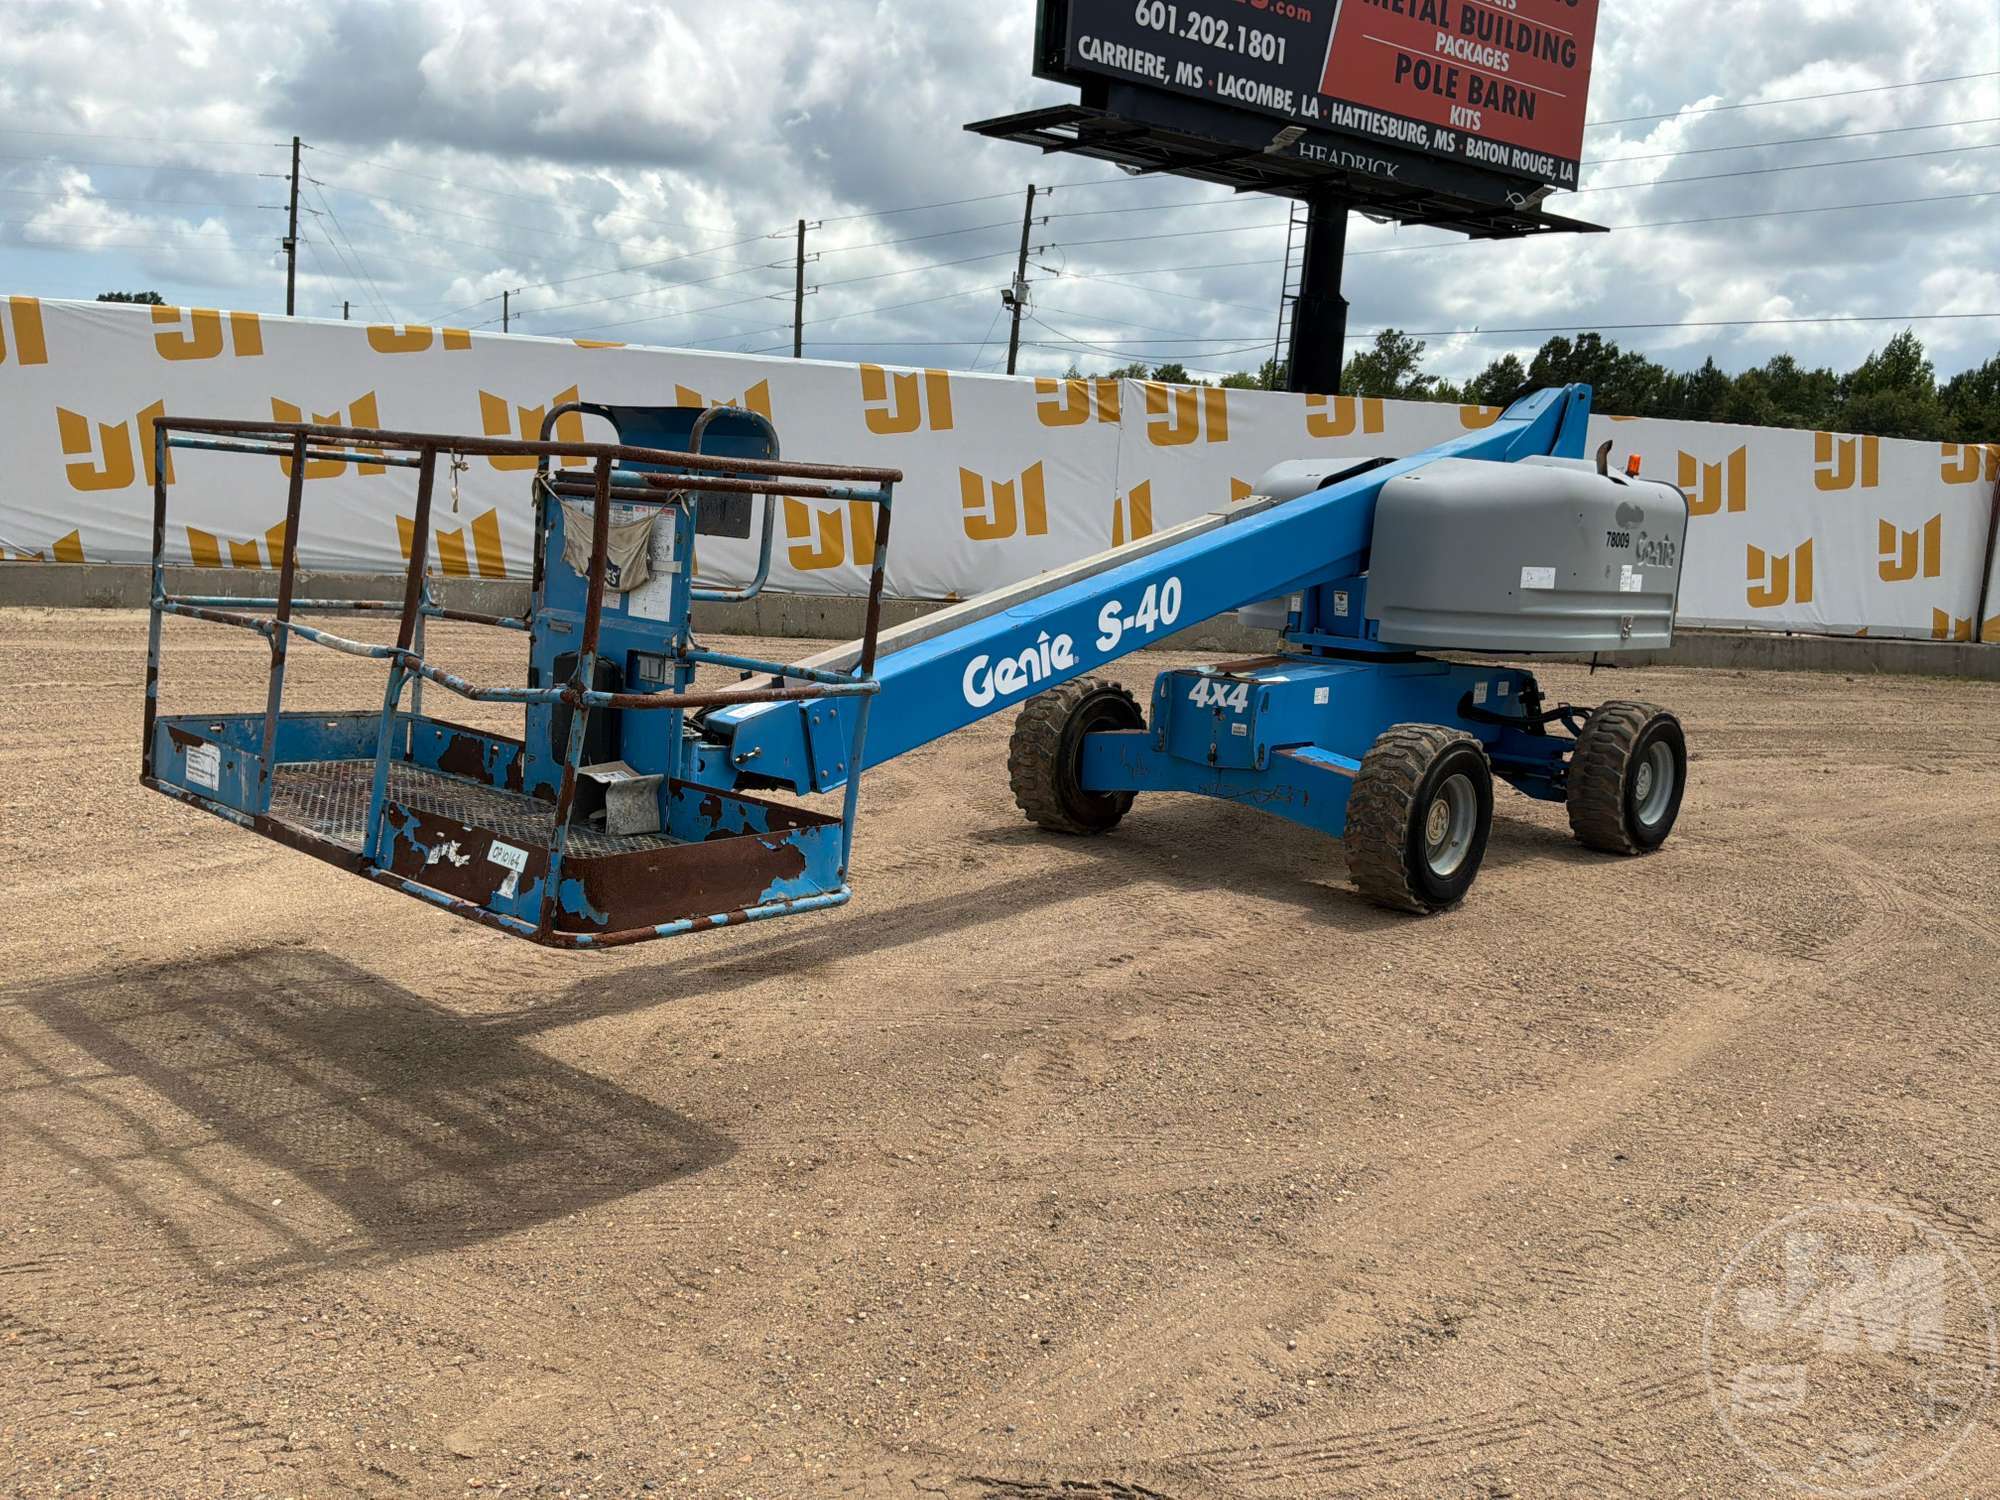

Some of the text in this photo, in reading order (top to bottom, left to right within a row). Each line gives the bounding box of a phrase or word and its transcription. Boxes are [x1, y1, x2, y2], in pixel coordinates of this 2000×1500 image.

[1135, 0, 1286, 65] 601.202.1801
[1435, 31, 1510, 72] PACKAGES
[1460, 4, 1577, 69] BUILDING
[1078, 35, 1574, 182] CARRIERE, MS LACOMBE, LA HATTIESBURG, MS BATON ROUGE, LA
[1394, 52, 1536, 121] POLE BARN
[1449, 104, 1482, 132] KITS
[1606, 530, 1630, 549] 78009
[962, 576, 1182, 708] Genie S-40
